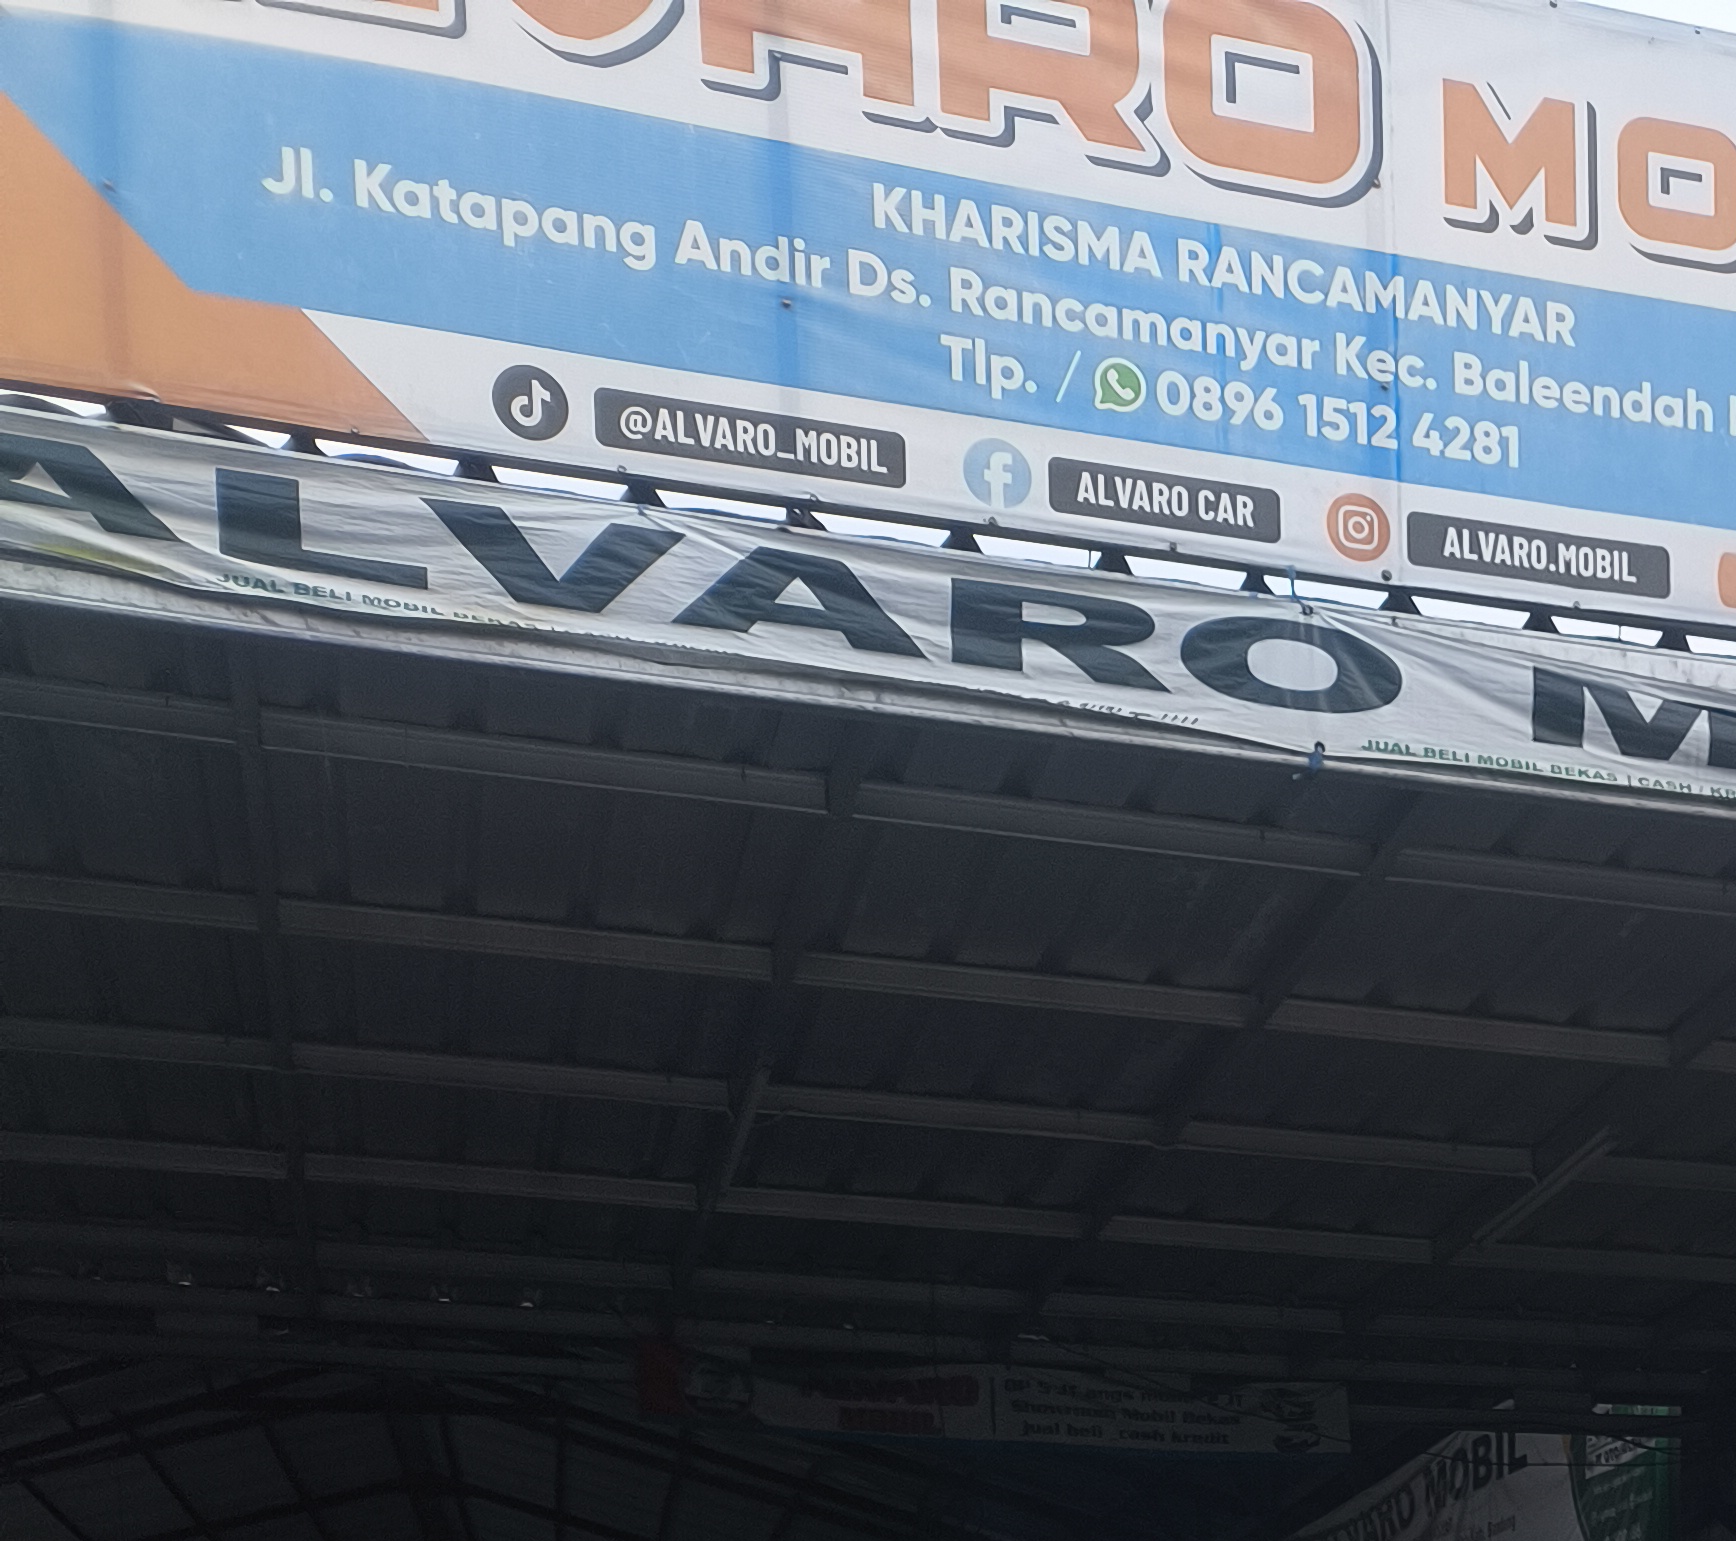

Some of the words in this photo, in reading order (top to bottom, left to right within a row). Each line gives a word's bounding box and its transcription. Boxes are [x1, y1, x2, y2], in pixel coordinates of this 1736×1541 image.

[261, 145, 334, 203] Jl.
[352, 158, 658, 271] Katapang
[673, 218, 832, 289] Andir
[848, 249, 932, 308] Ds.
[948, 265, 1321, 373] Rancamanyar
[1335, 331, 1438, 392] Kec.
[1452, 351, 1716, 435] Baleendah
[871, 181, 1162, 278] KHARISMA
[1177, 238, 1577, 347] RANCAMANYAR
[939, 333, 1039, 399] Tlp.
[1156, 369, 1285, 433] 0896
[1297, 392, 1399, 450] 1512
[1411, 411, 1521, 470] 4281
[618, 405, 889, 475] @ALVARO_MOBIL
[1076, 470, 1189, 519] ALVARO
[1198, 488, 1255, 528] CAR
[0, 434, 1403, 714] ALVARO
[216, 573, 284, 595] JUAL
[293, 580, 352, 603] BELI
[1442, 525, 1638, 584] ALVARO.MOBIL
[1360, 739, 1418, 757] JUAL
[1422, 746, 1470, 764] BELI
